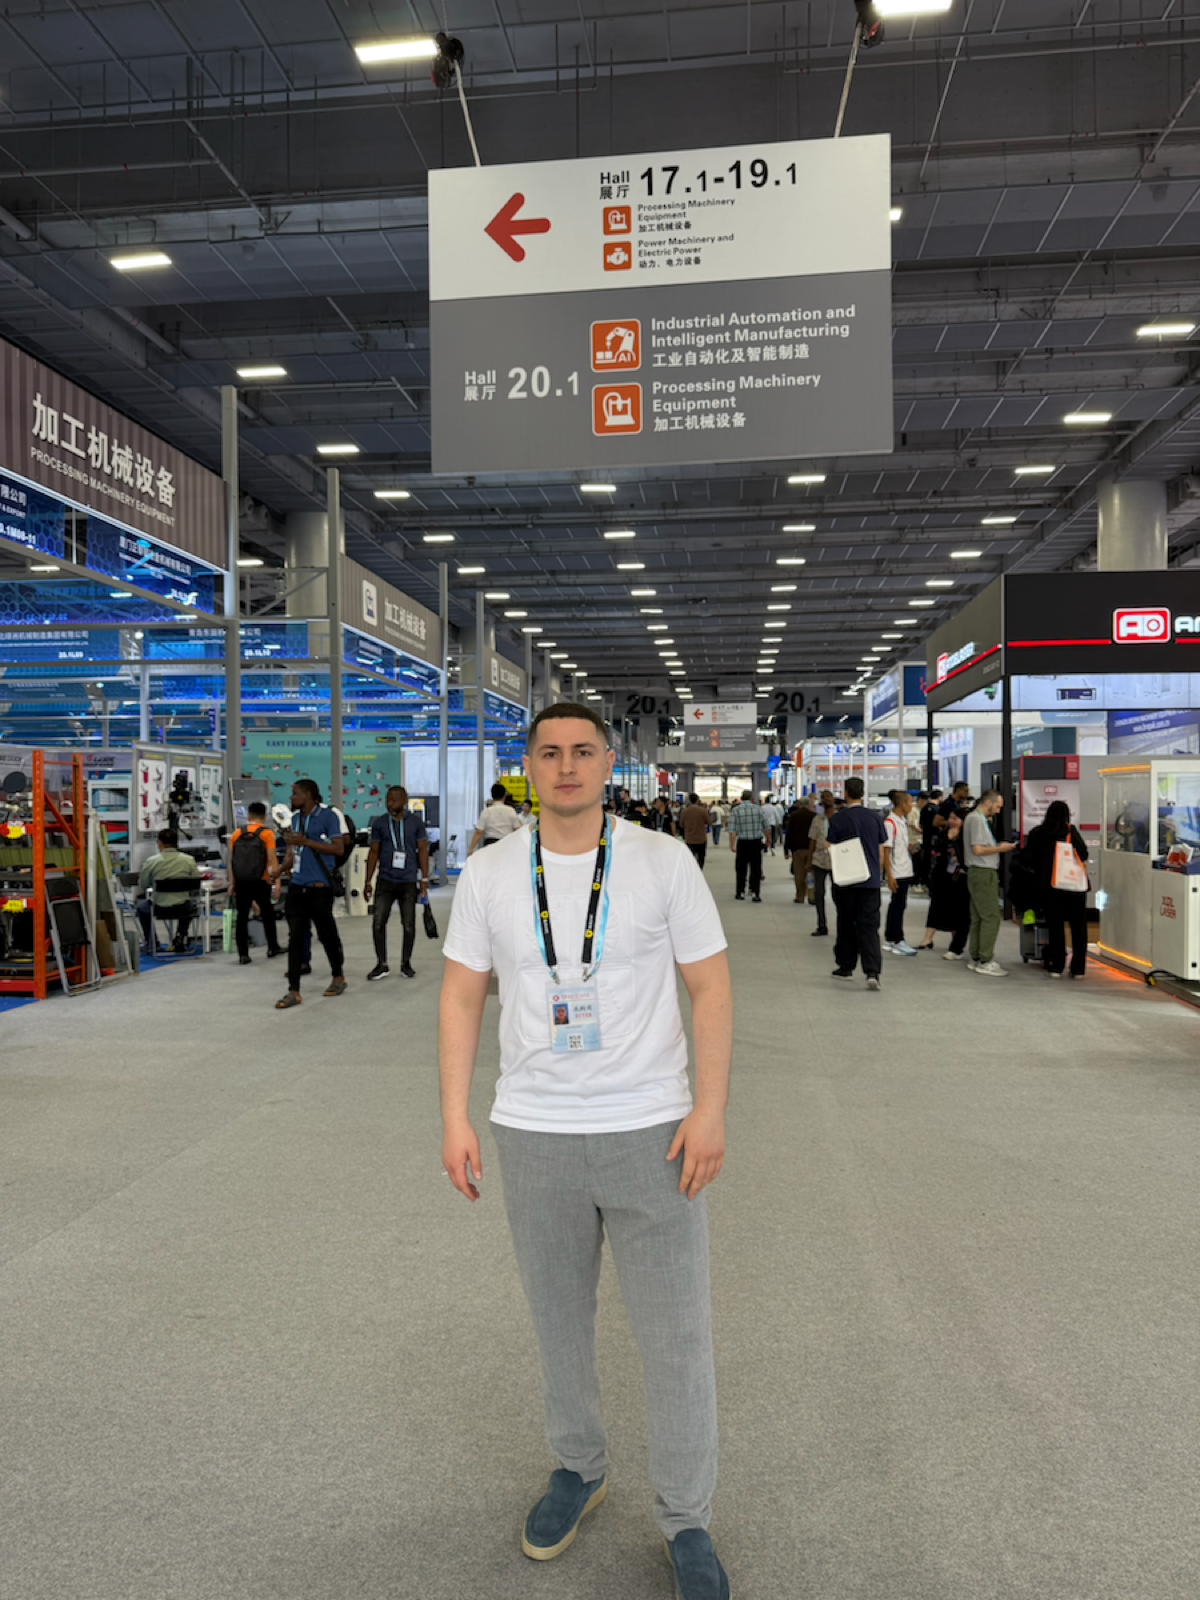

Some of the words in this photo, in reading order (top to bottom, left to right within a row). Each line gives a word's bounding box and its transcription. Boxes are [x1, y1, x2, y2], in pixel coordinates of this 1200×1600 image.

[600, 170, 630, 185] Hall
[640, 158, 797, 196] 17.1-19.1
[599, 185, 630, 199] 展厅
[637, 201, 686, 212] Processing
[687, 198, 736, 208] Machinery
[637, 211, 687, 222] Equipment
[638, 221, 692, 233] 加工机械设备
[638, 239, 666, 248] Power
[667, 235, 716, 246] Machinery
[717, 232, 735, 242] and
[638, 248, 672, 257] Electric
[672, 247, 702, 255] Power
[638, 256, 702, 269] 动力、电力设备
[651, 313, 725, 331] Industrial
[728, 308, 822, 326] Automation
[826, 304, 856, 320] and
[651, 331, 731, 348] Intelligent
[734, 323, 850, 343] Manufacturing
[652, 343, 810, 368] 工业自动化及智能制造
[464, 385, 496, 401] 展厅
[465, 370, 496, 385] Hall
[507, 365, 579, 400] 20.1
[652, 377, 736, 395] Processing
[739, 373, 821, 390] Machinery
[652, 396, 737, 414] Equipment
[653, 411, 747, 432] 加工机械设备
[31, 392, 176, 508] 加工机械设备
[30, 446, 89, 485] PROCESSING
[89, 476, 135, 508] MACHINERY
[135, 499, 176, 528] EQUIPMENT
[626, 694, 670, 715] 20.1
[774, 691, 820, 713] 20.1
[266, 740, 285, 748] EAST
[287, 740, 309, 748] FIELD
